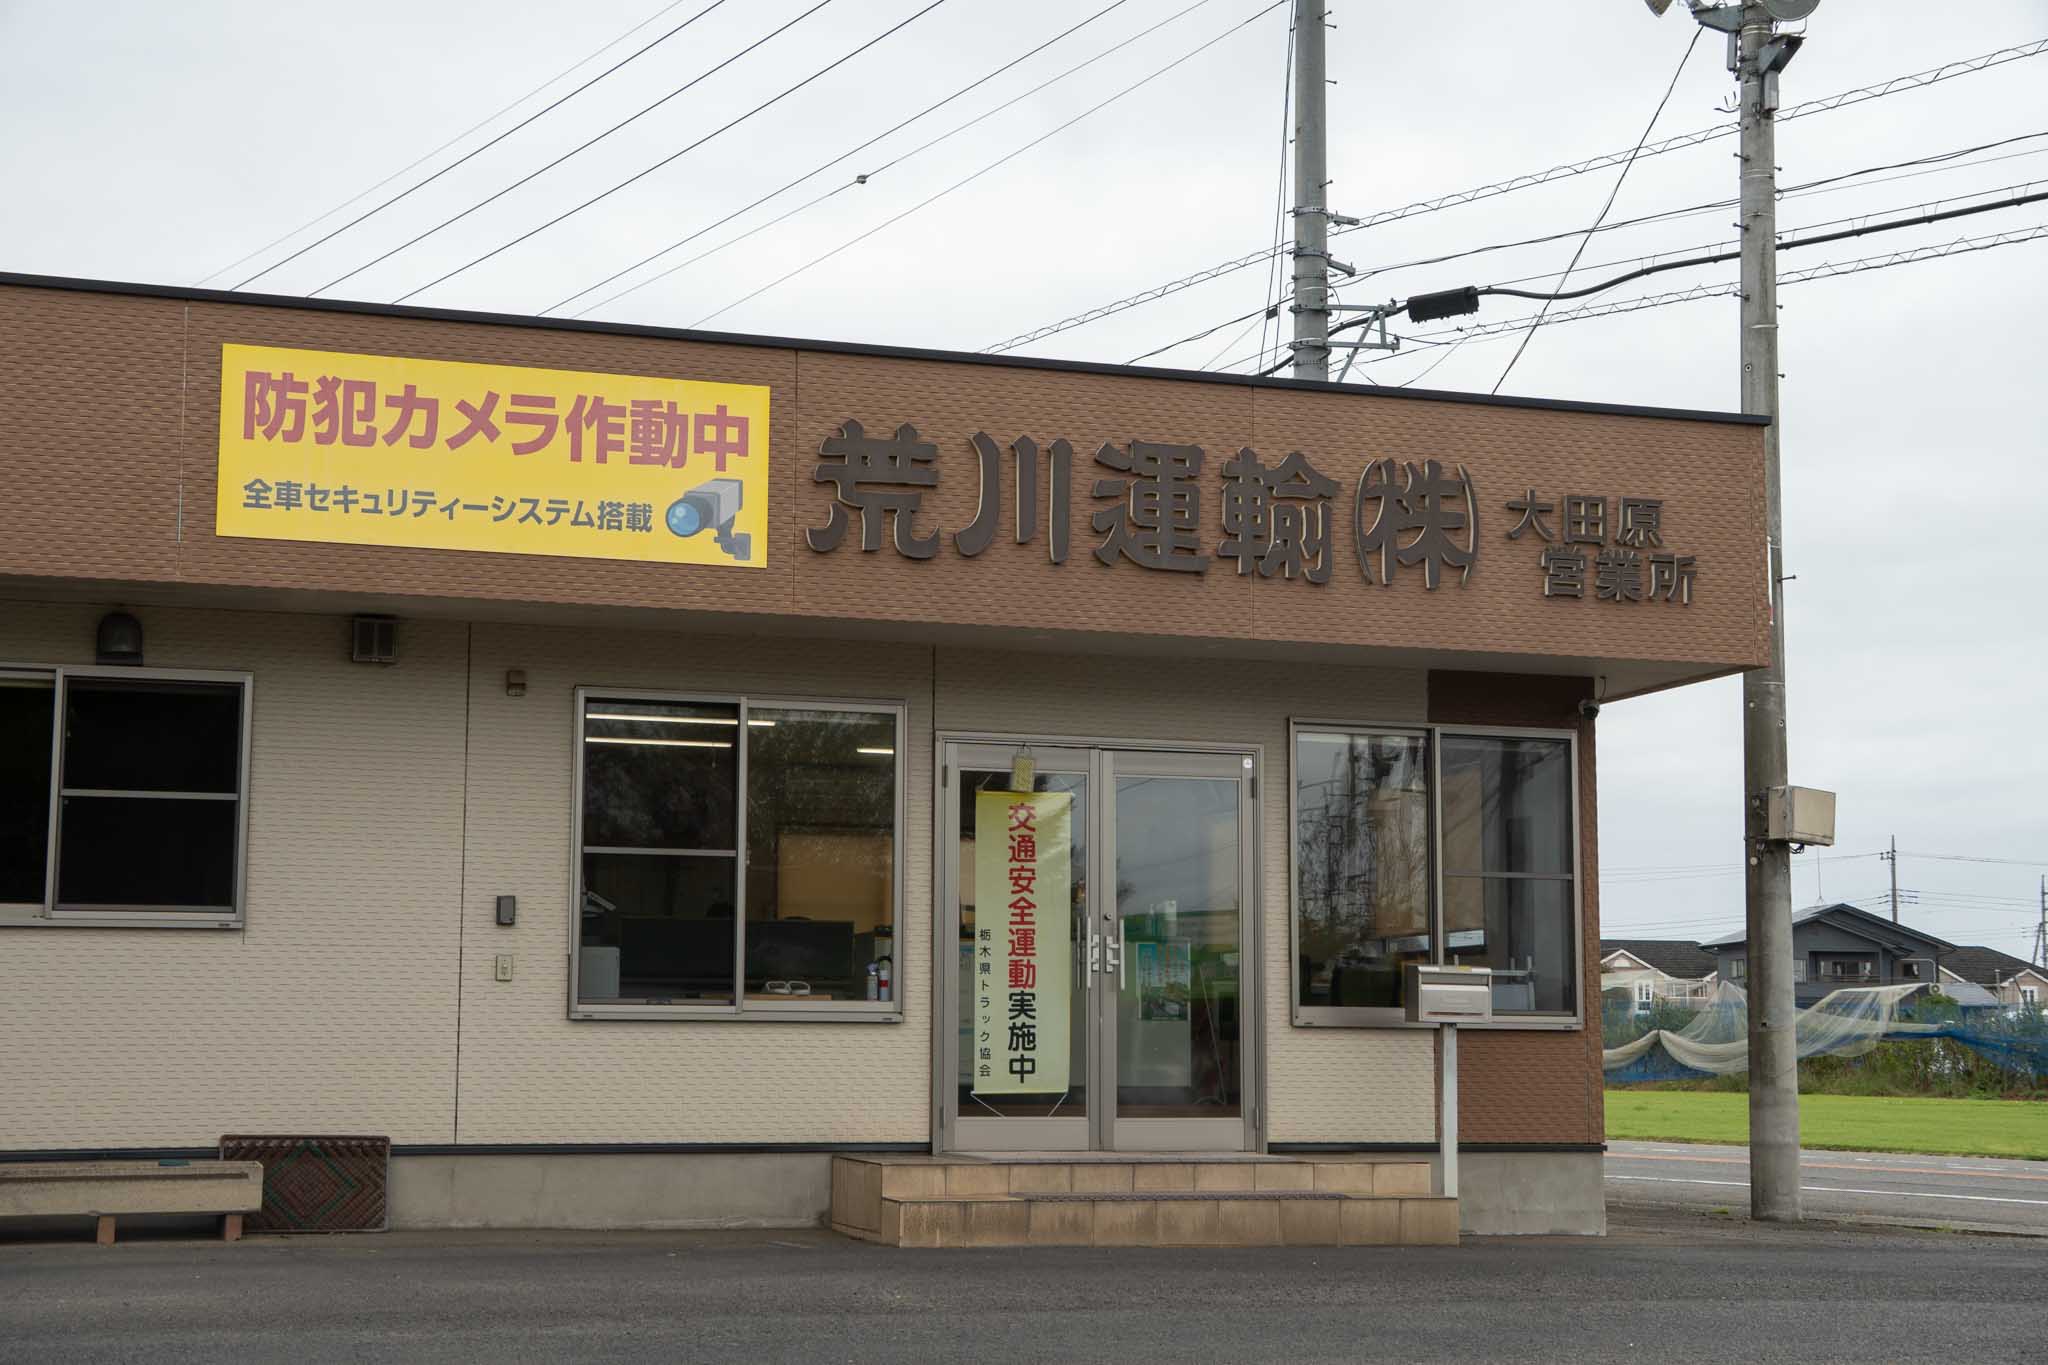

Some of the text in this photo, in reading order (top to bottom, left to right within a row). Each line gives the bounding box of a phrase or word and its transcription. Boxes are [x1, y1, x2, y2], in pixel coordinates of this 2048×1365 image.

[243, 371, 749, 472] 防犯カメラ作動中
[243, 478, 653, 533] 全車セキュリティーシステム搭載
[1506, 488, 1664, 549] 大田原
[1541, 545, 1697, 605] 営業所
[1008, 802, 1037, 1084] 交通安全運動実施中
[979, 928, 991, 1078] 栃木県トラック協会
